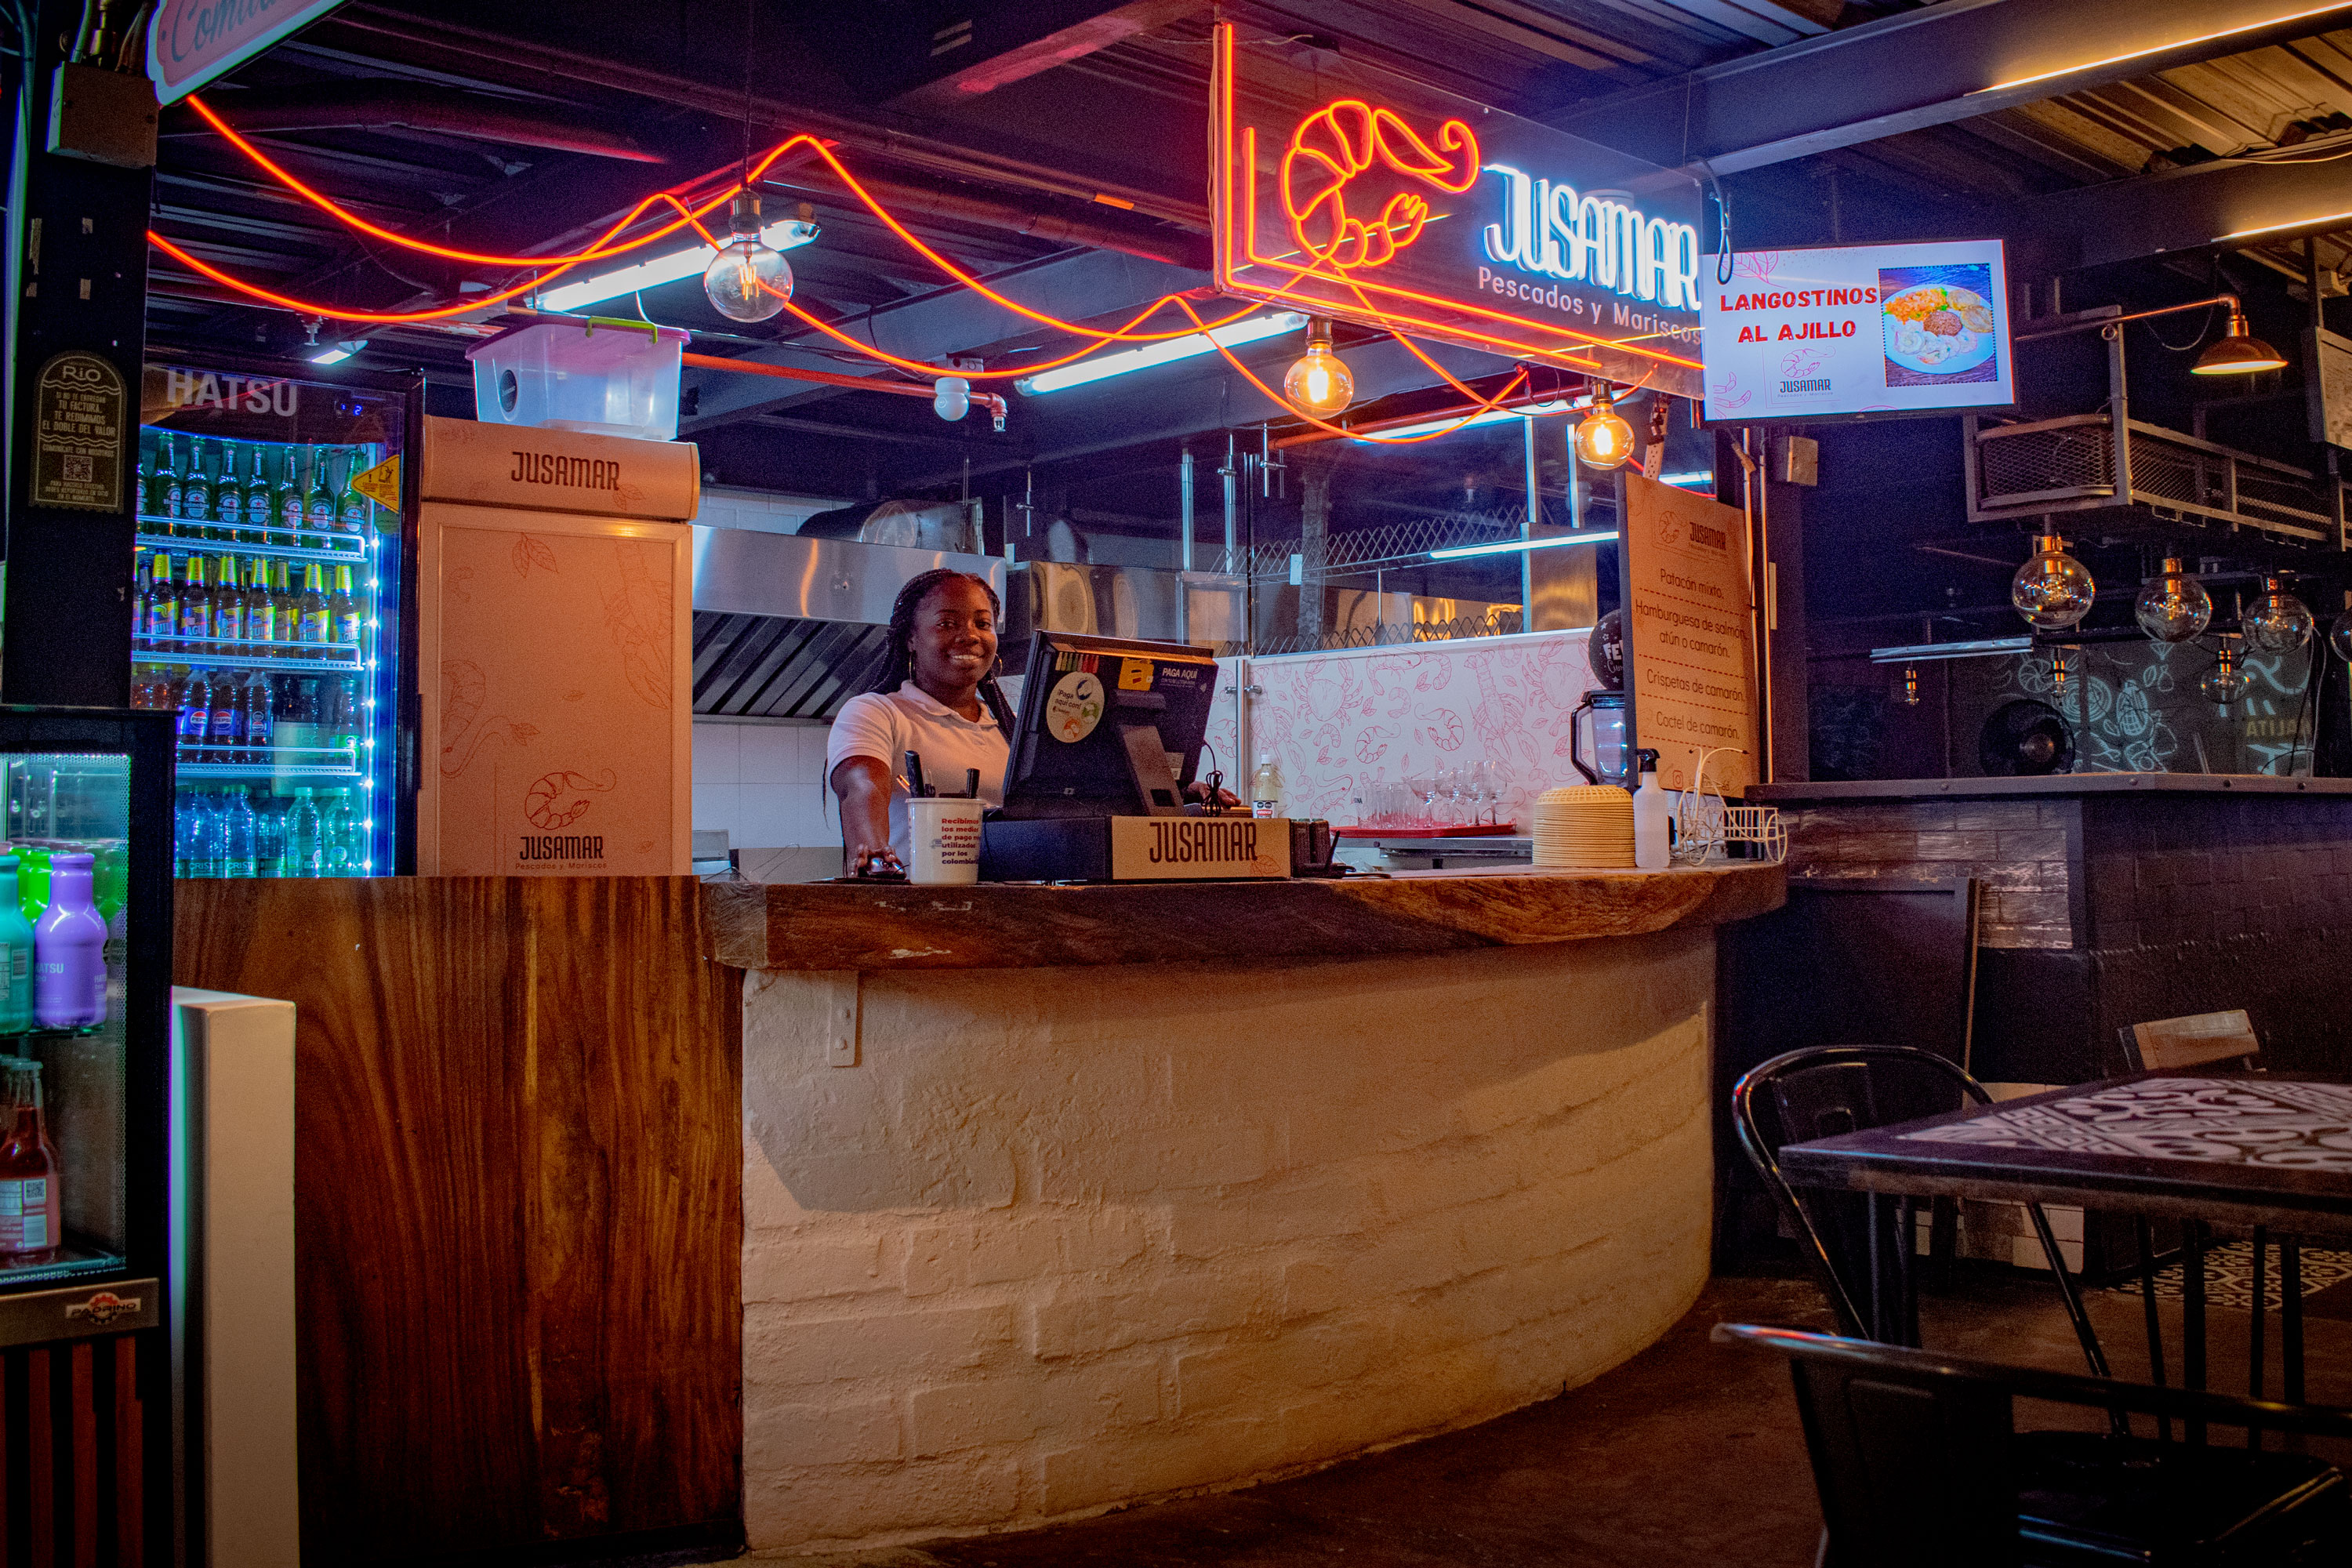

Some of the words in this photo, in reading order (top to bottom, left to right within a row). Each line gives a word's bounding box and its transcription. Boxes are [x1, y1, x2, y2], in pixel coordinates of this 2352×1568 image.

[1482, 164, 1701, 311] JUSAMAR
[1479, 266, 1584, 315] Pescados
[1590, 301, 1602, 325] y
[1613, 302, 1702, 345] Mariscos
[1719, 287, 1878, 312] LANGOSTINOS
[1737, 325, 1769, 343] AL
[1777, 320, 1857, 342] AJILLO
[166, 367, 298, 417] HATSU
[1779, 378, 1831, 394] JUSAMAR
[53, 421, 76, 433] DOBLE
[78, 423, 91, 434] DEL
[510, 451, 620, 492] JUSAMAR
[1689, 521, 1726, 550] JUSAMAR
[1660, 568, 1697, 591] Patacón
[1698, 581, 1725, 599] mixto.
[1635, 598, 1700, 627] Hamburguesa
[1701, 616, 1714, 632] de
[1659, 630, 1680, 646] atún
[1682, 637, 1689, 648] o
[1689, 637, 1730, 659] camarón.
[1162, 667, 1181, 677] PAGA
[1646, 668, 1690, 691] Crispetas
[1692, 678, 1704, 695] de
[1704, 684, 1746, 702] camarón.
[1656, 710, 1685, 730] Coctel
[1686, 716, 1698, 733] de
[1699, 722, 1740, 740] camarón.
[519, 835, 604, 861] JUSAMAR
[1149, 821, 1258, 864] JUSAMAR
[71, 1302, 136, 1316] PADRINO
